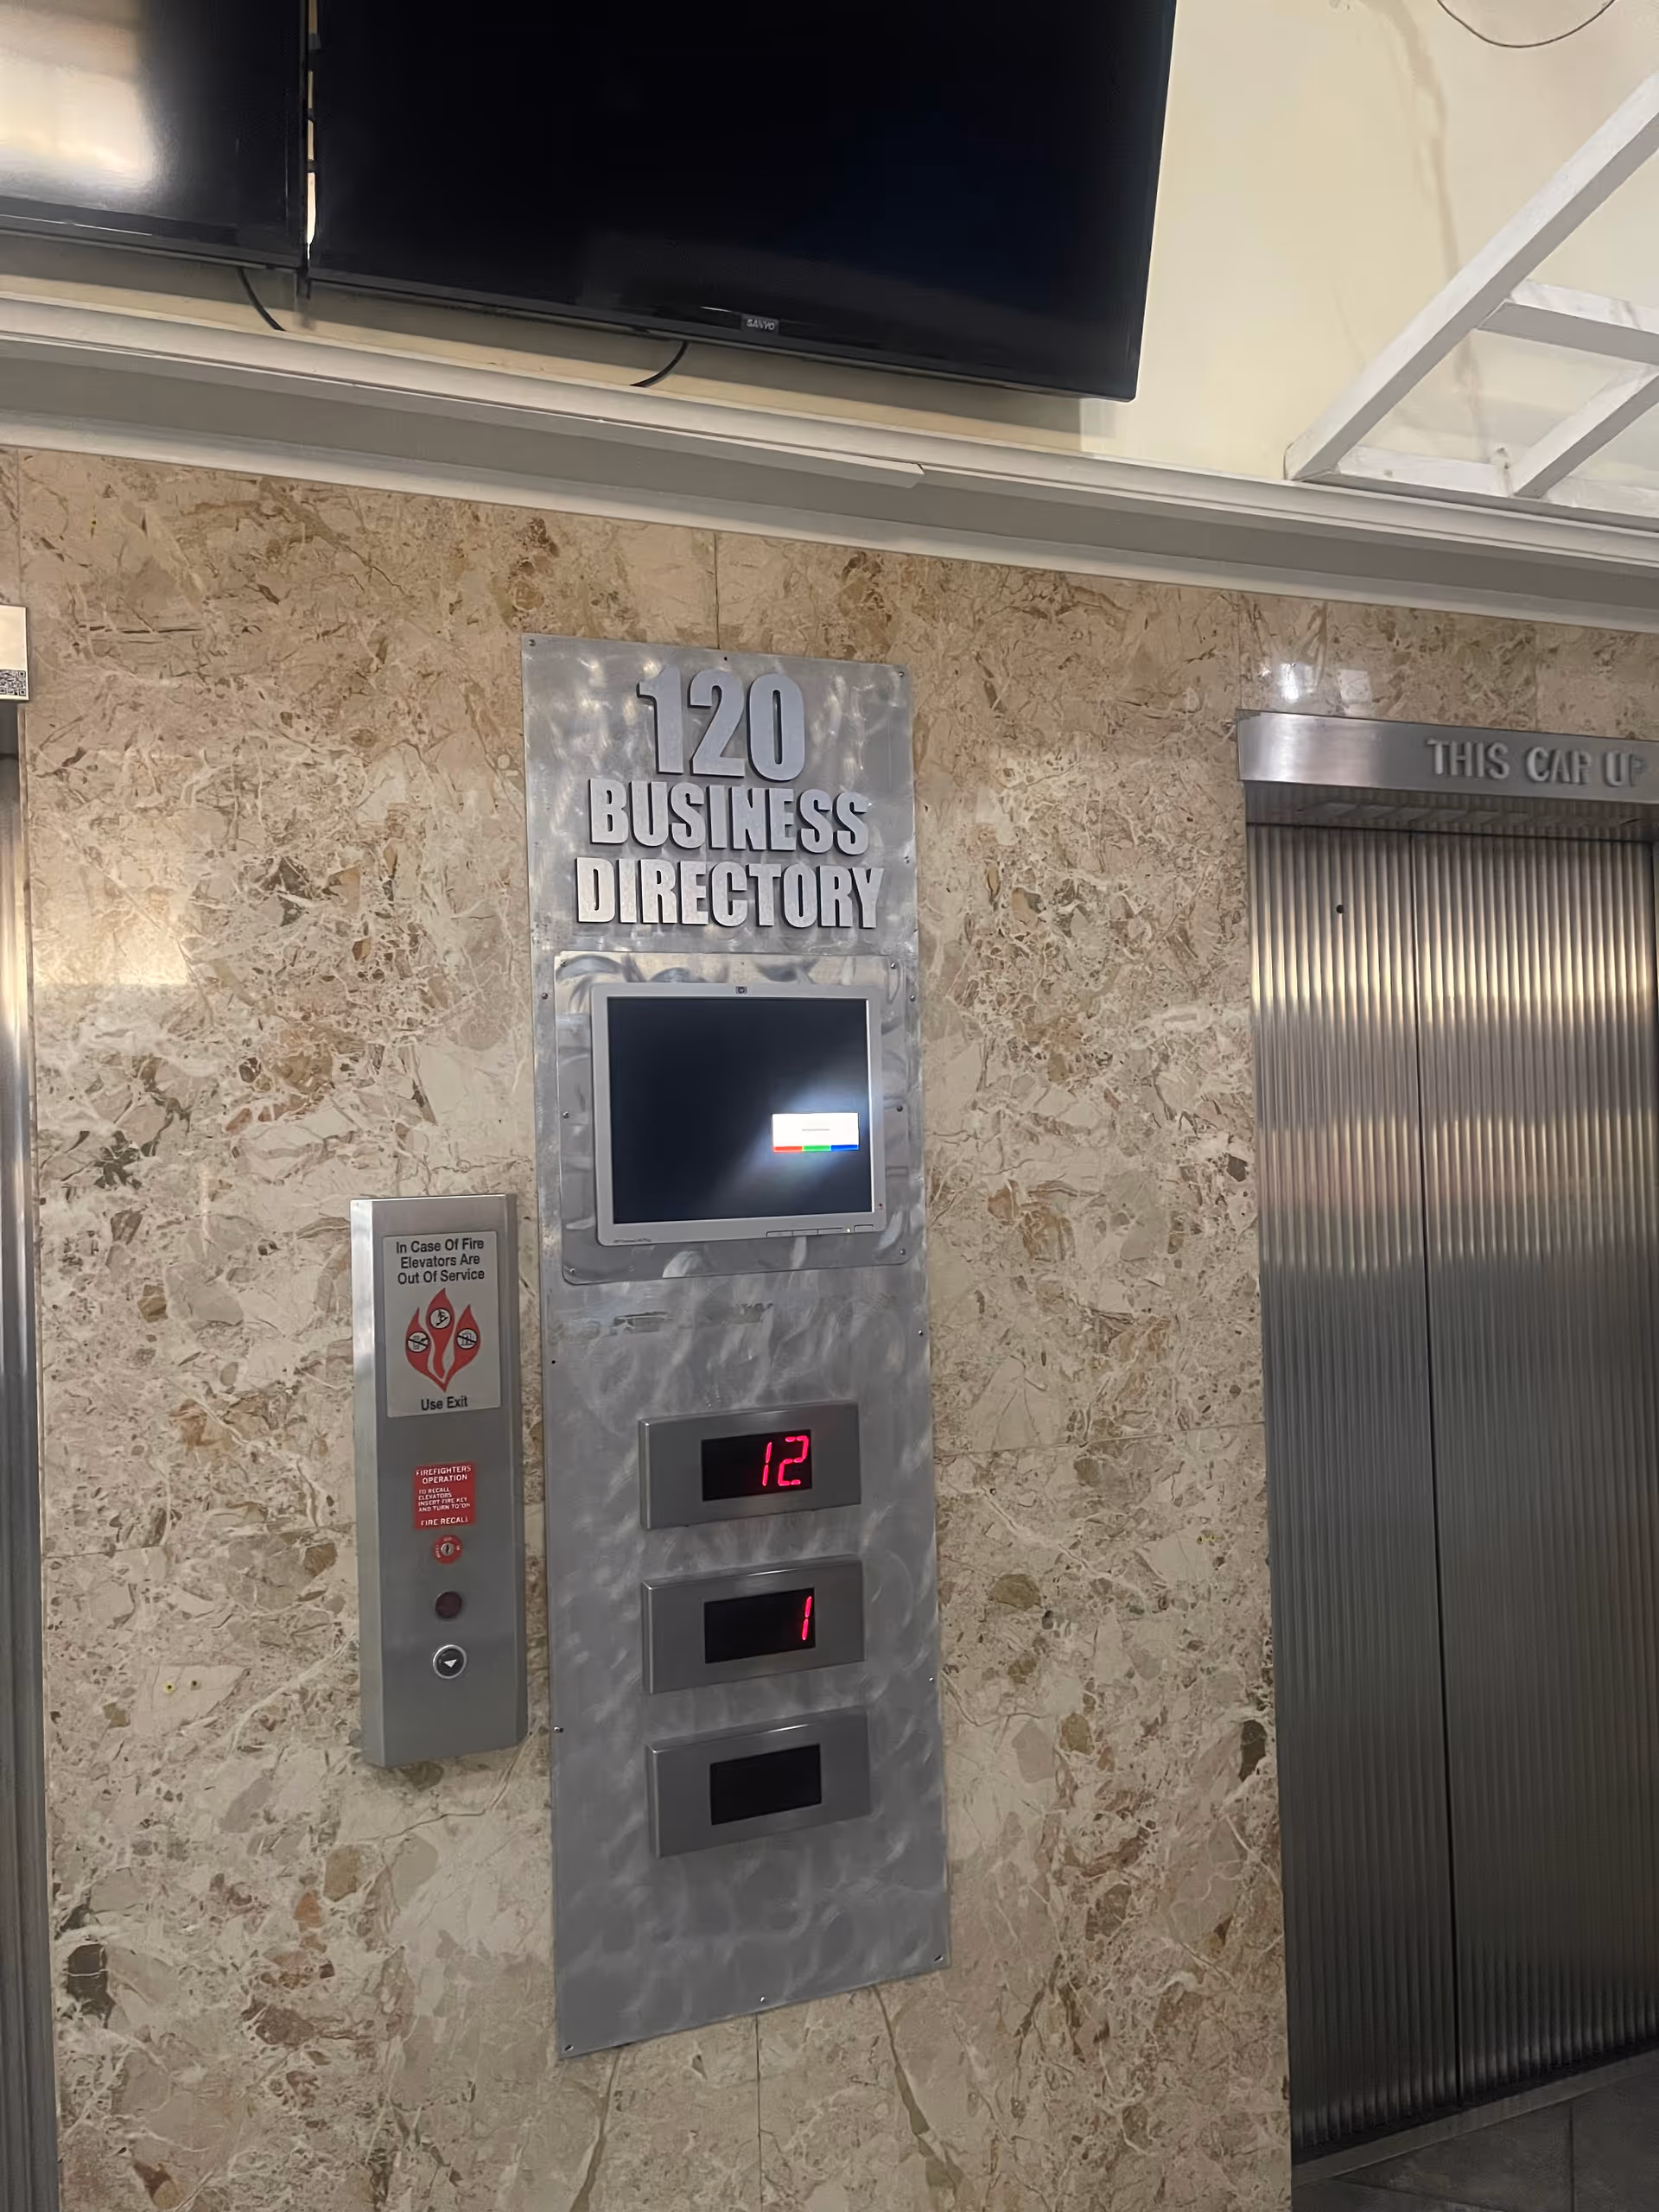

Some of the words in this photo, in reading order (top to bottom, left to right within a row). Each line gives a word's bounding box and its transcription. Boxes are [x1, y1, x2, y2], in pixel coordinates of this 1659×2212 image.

[747, 318, 775, 331] SANYO
[636, 664, 805, 782] 120
[1426, 739, 1511, 780] THIS
[1526, 746, 1592, 785] CAR
[588, 778, 869, 856] BUSINESS
[575, 856, 885, 929] DIRECTORY
[396, 1241, 407, 1254] In
[410, 1240, 442, 1253] Case
[445, 1238, 459, 1251] Of
[462, 1237, 485, 1250] Fire
[400, 1255, 457, 1269] Elevators
[460, 1253, 480, 1266] Are
[397, 1272, 420, 1285] Out
[423, 1270, 437, 1283] Of
[440, 1268, 485, 1282] Service
[421, 1398, 443, 1411] Use
[447, 1395, 468, 1409] Exit
[761, 1433, 810, 1488] 12
[422, 1473, 467, 1484] OPERATION
[418, 1492, 452, 1501] ELEVATORS
[421, 1518, 439, 1527] FIRE
[440, 1516, 469, 1525] RECALL
[800, 1595, 812, 1642] 1
